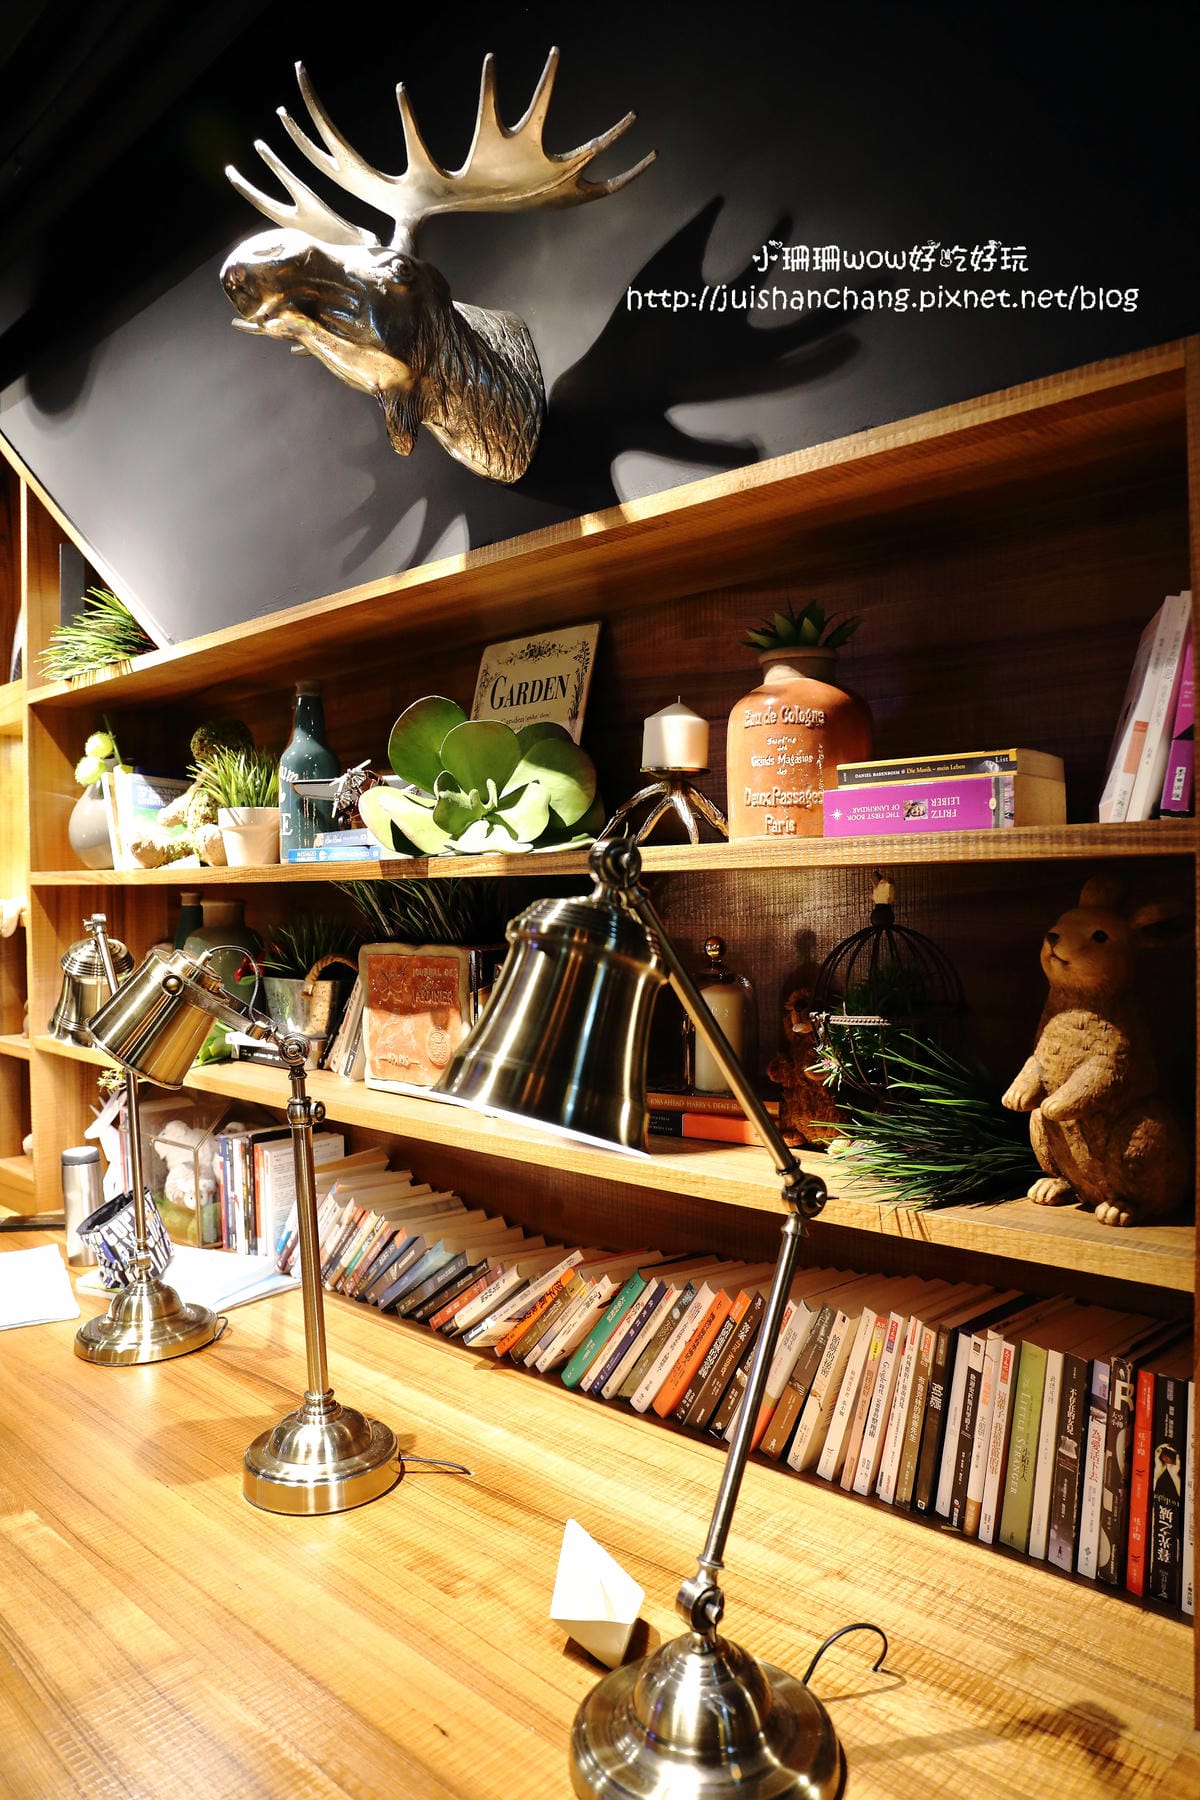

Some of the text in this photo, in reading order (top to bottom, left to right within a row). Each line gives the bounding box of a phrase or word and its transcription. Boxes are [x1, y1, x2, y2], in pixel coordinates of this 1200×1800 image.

[489, 673, 571, 711] GARDEN
[762, 705, 777, 725] de
[780, 705, 825, 727] Cologne
[931, 796, 961, 807] LEIBER
[765, 813, 798, 835] Paris
[931, 809, 957, 819] FRITZ
[1157, 1505, 1174, 1563] 暮光之城
